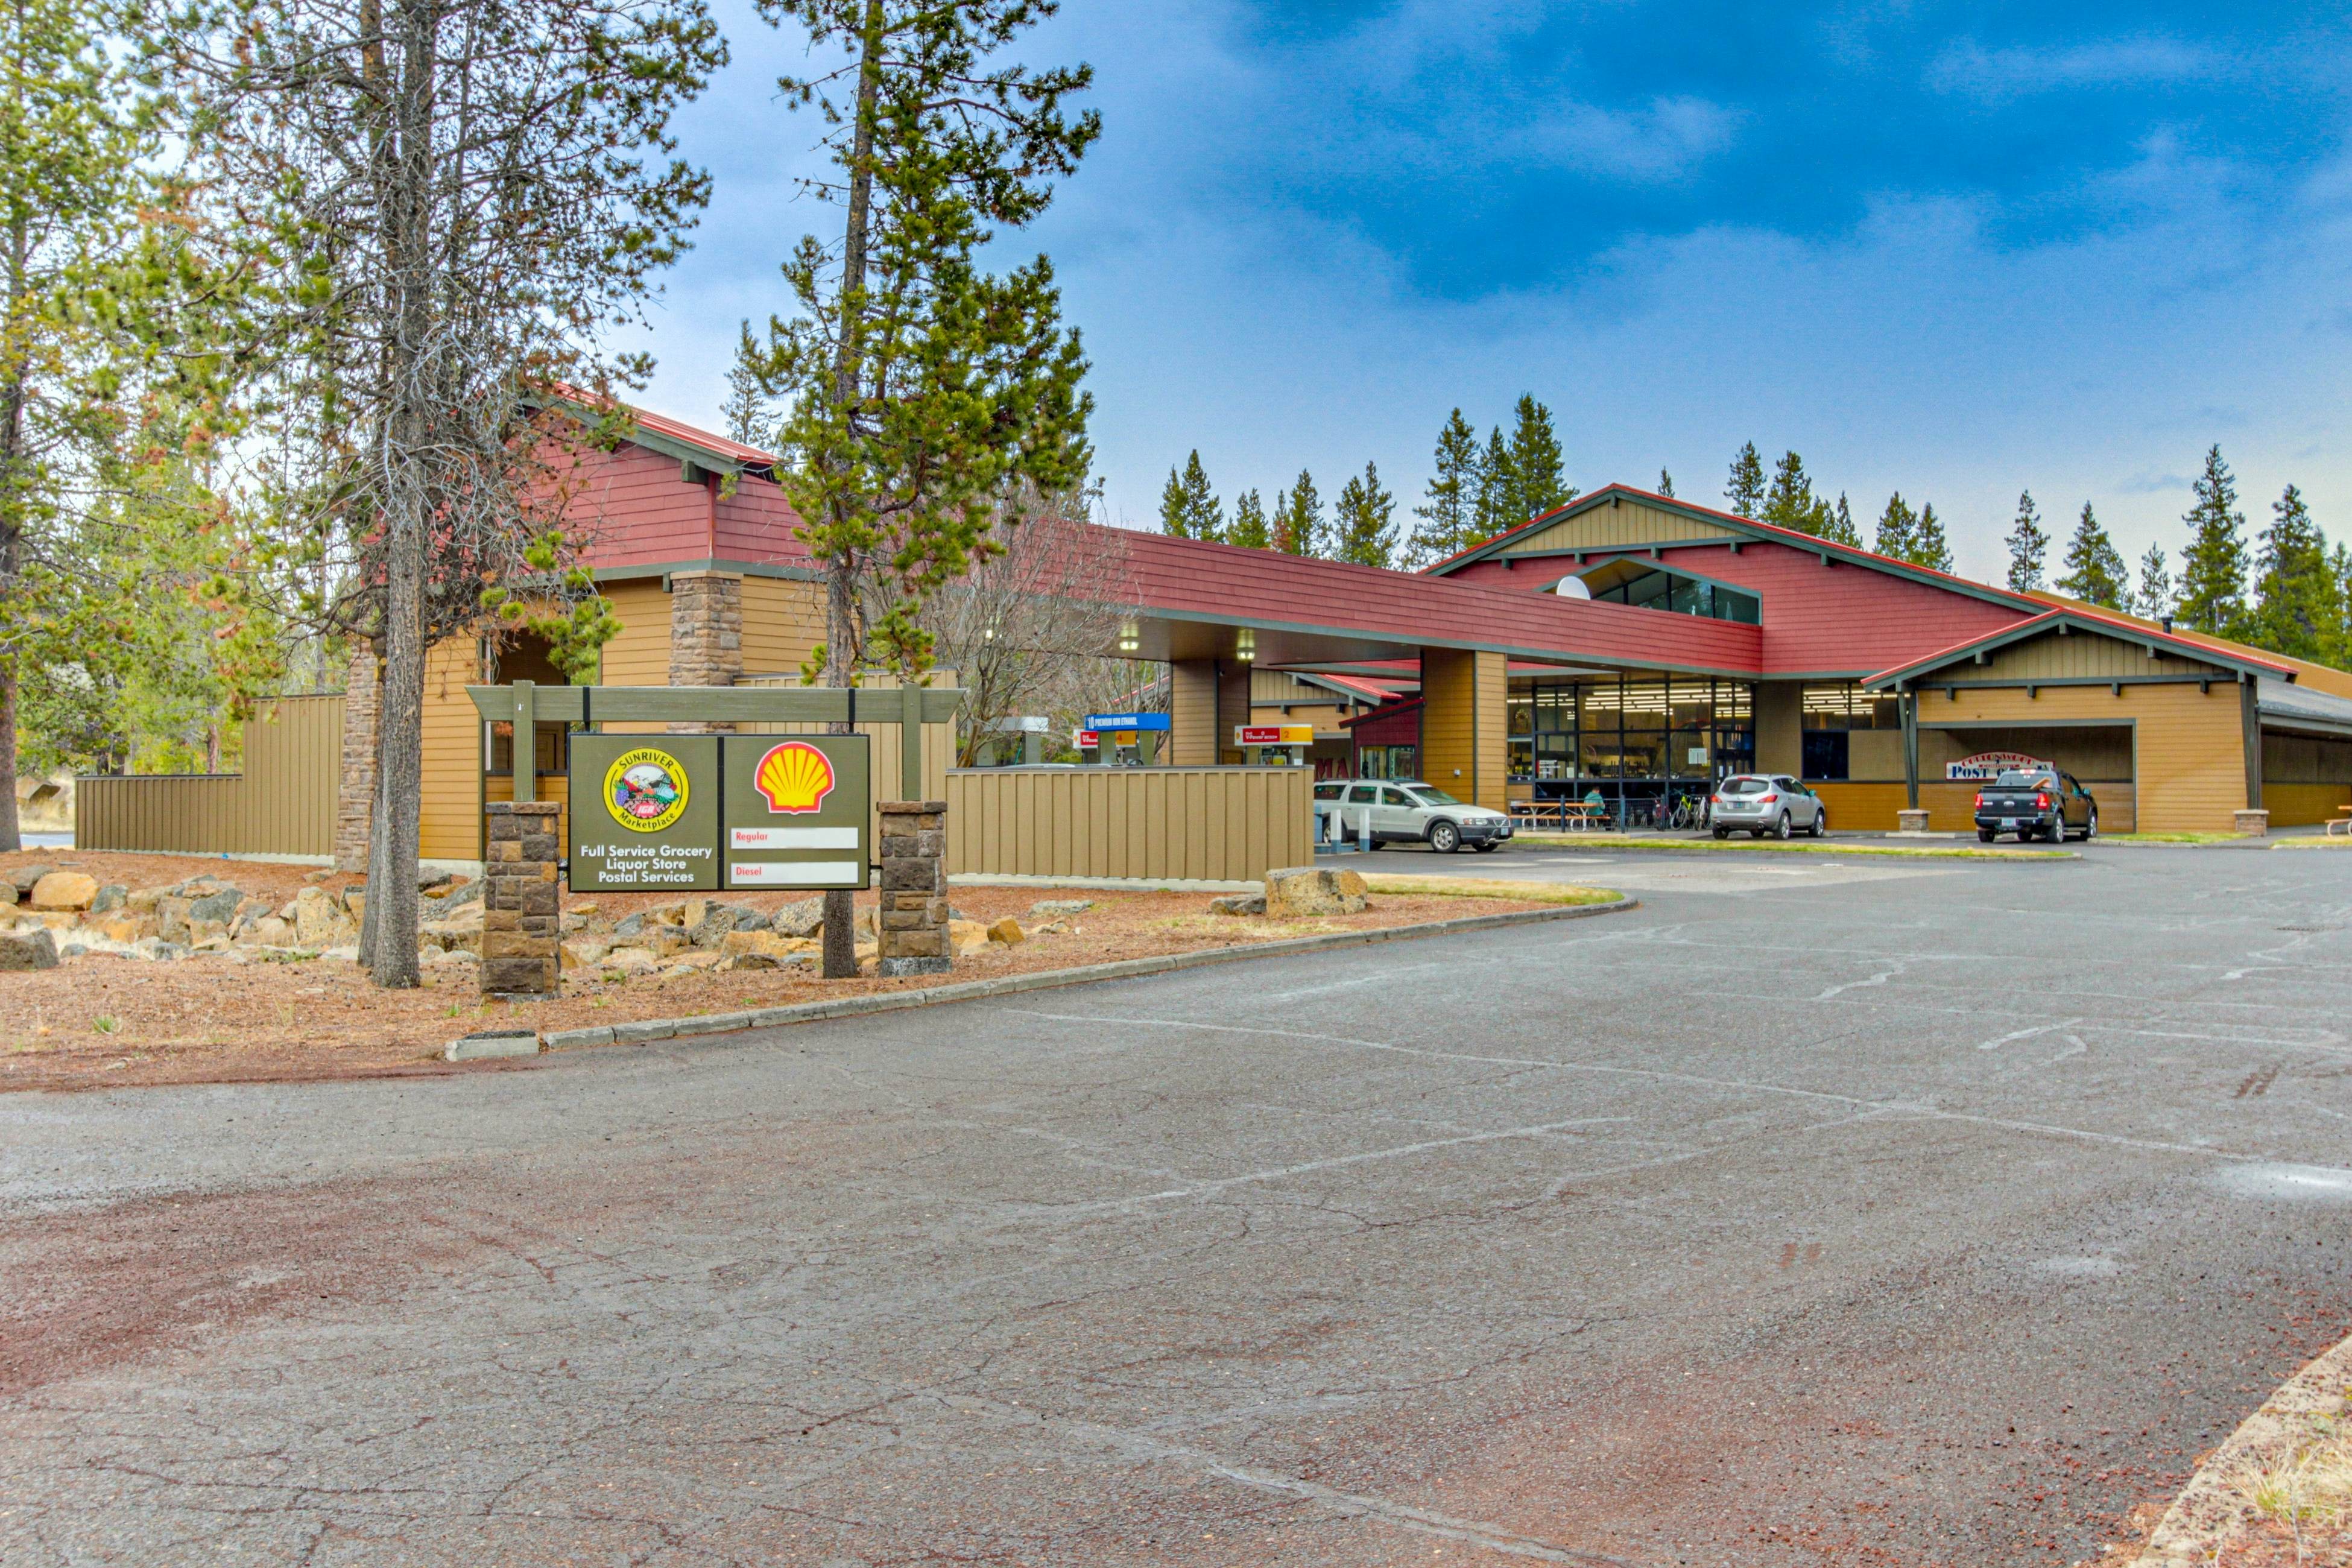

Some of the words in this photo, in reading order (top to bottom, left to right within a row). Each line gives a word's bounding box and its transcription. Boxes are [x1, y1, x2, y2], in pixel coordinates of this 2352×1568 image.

[1284, 730, 1289, 739] 2
[619, 752, 674, 770] SUNRIVER
[1952, 765, 1989, 779] POST
[637, 805, 655, 814] IGA
[619, 812, 675, 830] Marketplace
[736, 832, 768, 843] Regular
[581, 845, 604, 857] Full
[609, 845, 656, 857] Service
[660, 845, 712, 859] Grocery
[607, 858, 649, 872] Liquor
[653, 858, 687, 870] Store
[736, 867, 762, 876] Diesel
[598, 871, 637, 883] Postal
[641, 871, 694, 883] Services
